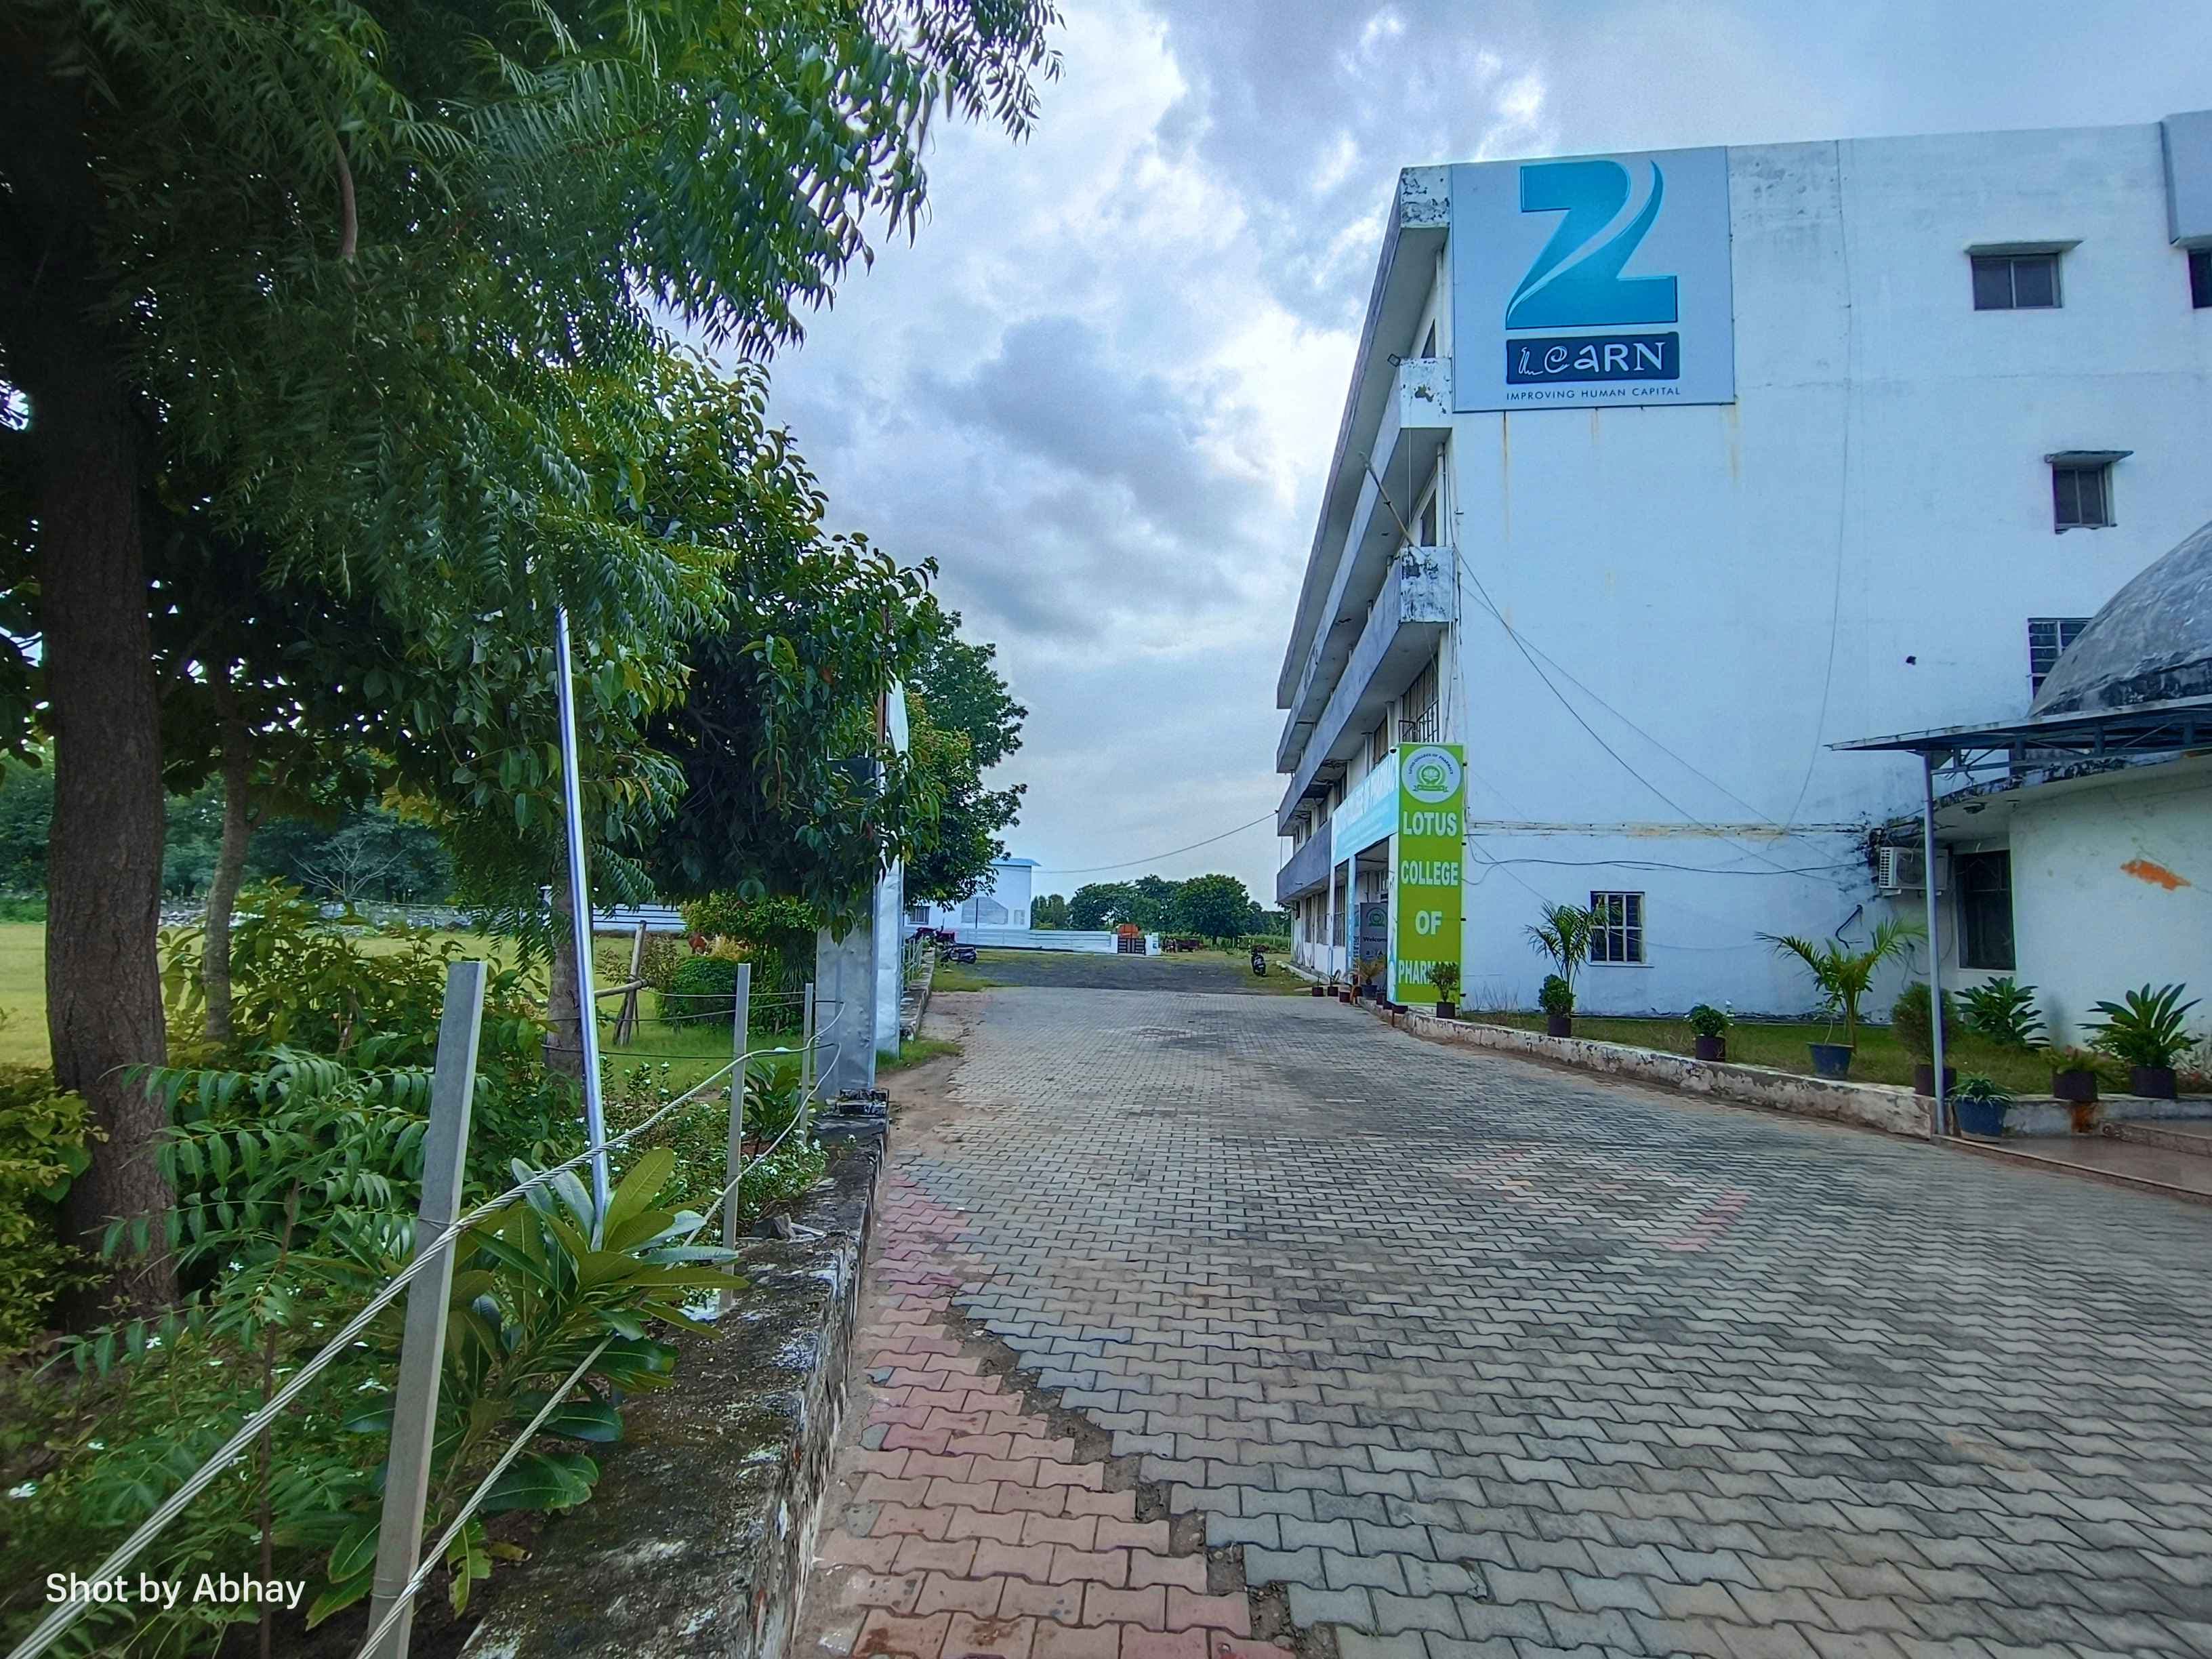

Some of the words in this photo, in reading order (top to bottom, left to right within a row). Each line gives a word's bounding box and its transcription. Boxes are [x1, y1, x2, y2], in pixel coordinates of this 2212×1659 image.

[1507, 390, 1575, 401] IMPROVING
[1581, 388, 1626, 398] HUMAN
[1632, 387, 1681, 396] CAPITAL
[1403, 811, 1458, 836] LOTUS
[1401, 860, 1458, 886] COLLEGE
[1415, 910, 1442, 935] OF
